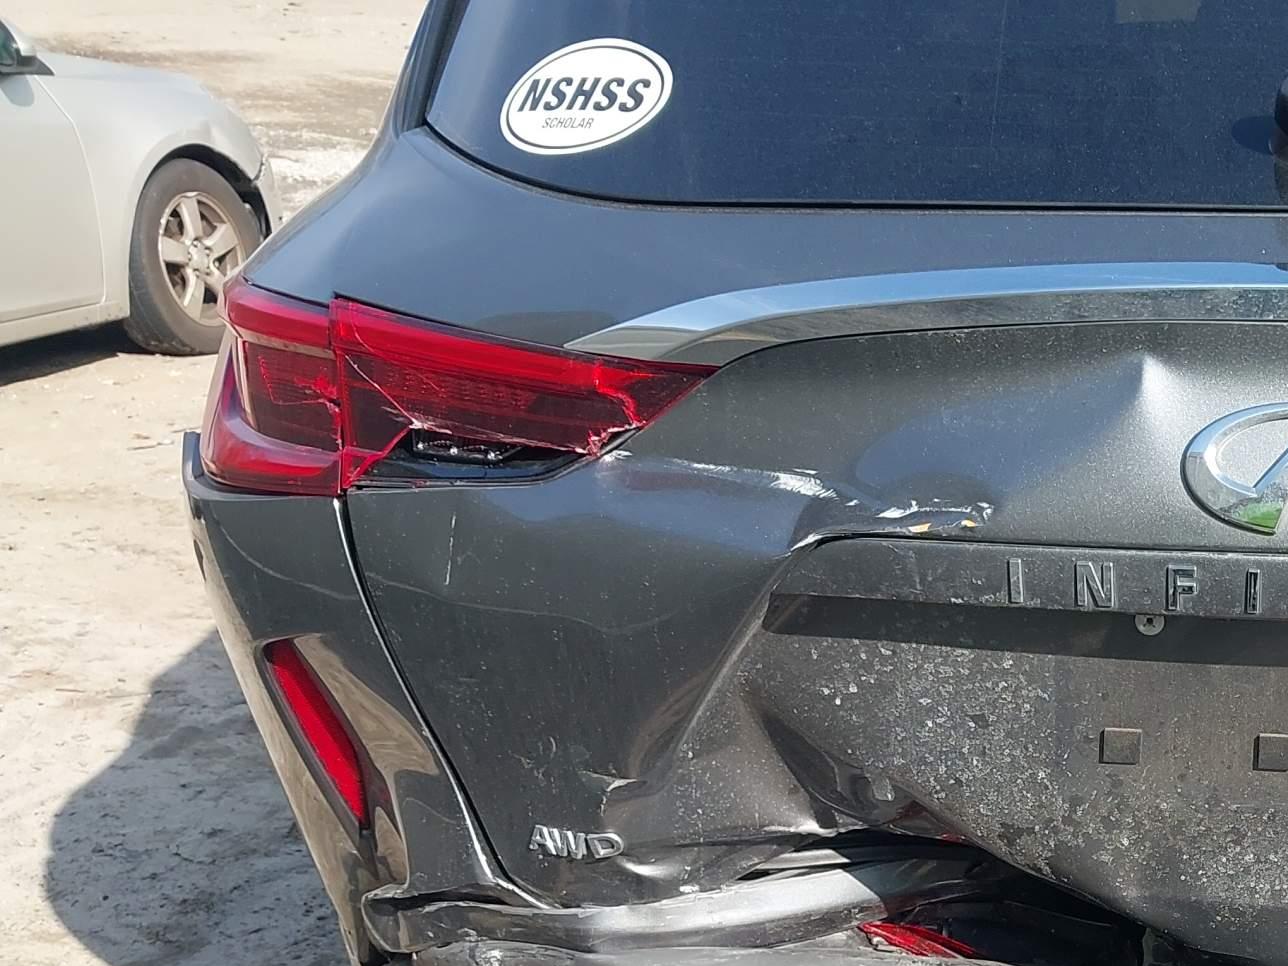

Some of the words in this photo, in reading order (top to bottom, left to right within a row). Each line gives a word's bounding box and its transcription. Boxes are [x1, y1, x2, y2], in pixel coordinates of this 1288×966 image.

[517, 77, 651, 113] NSHSS
[541, 117, 594, 129] SCHOLAR
[529, 825, 624, 860] AWD
